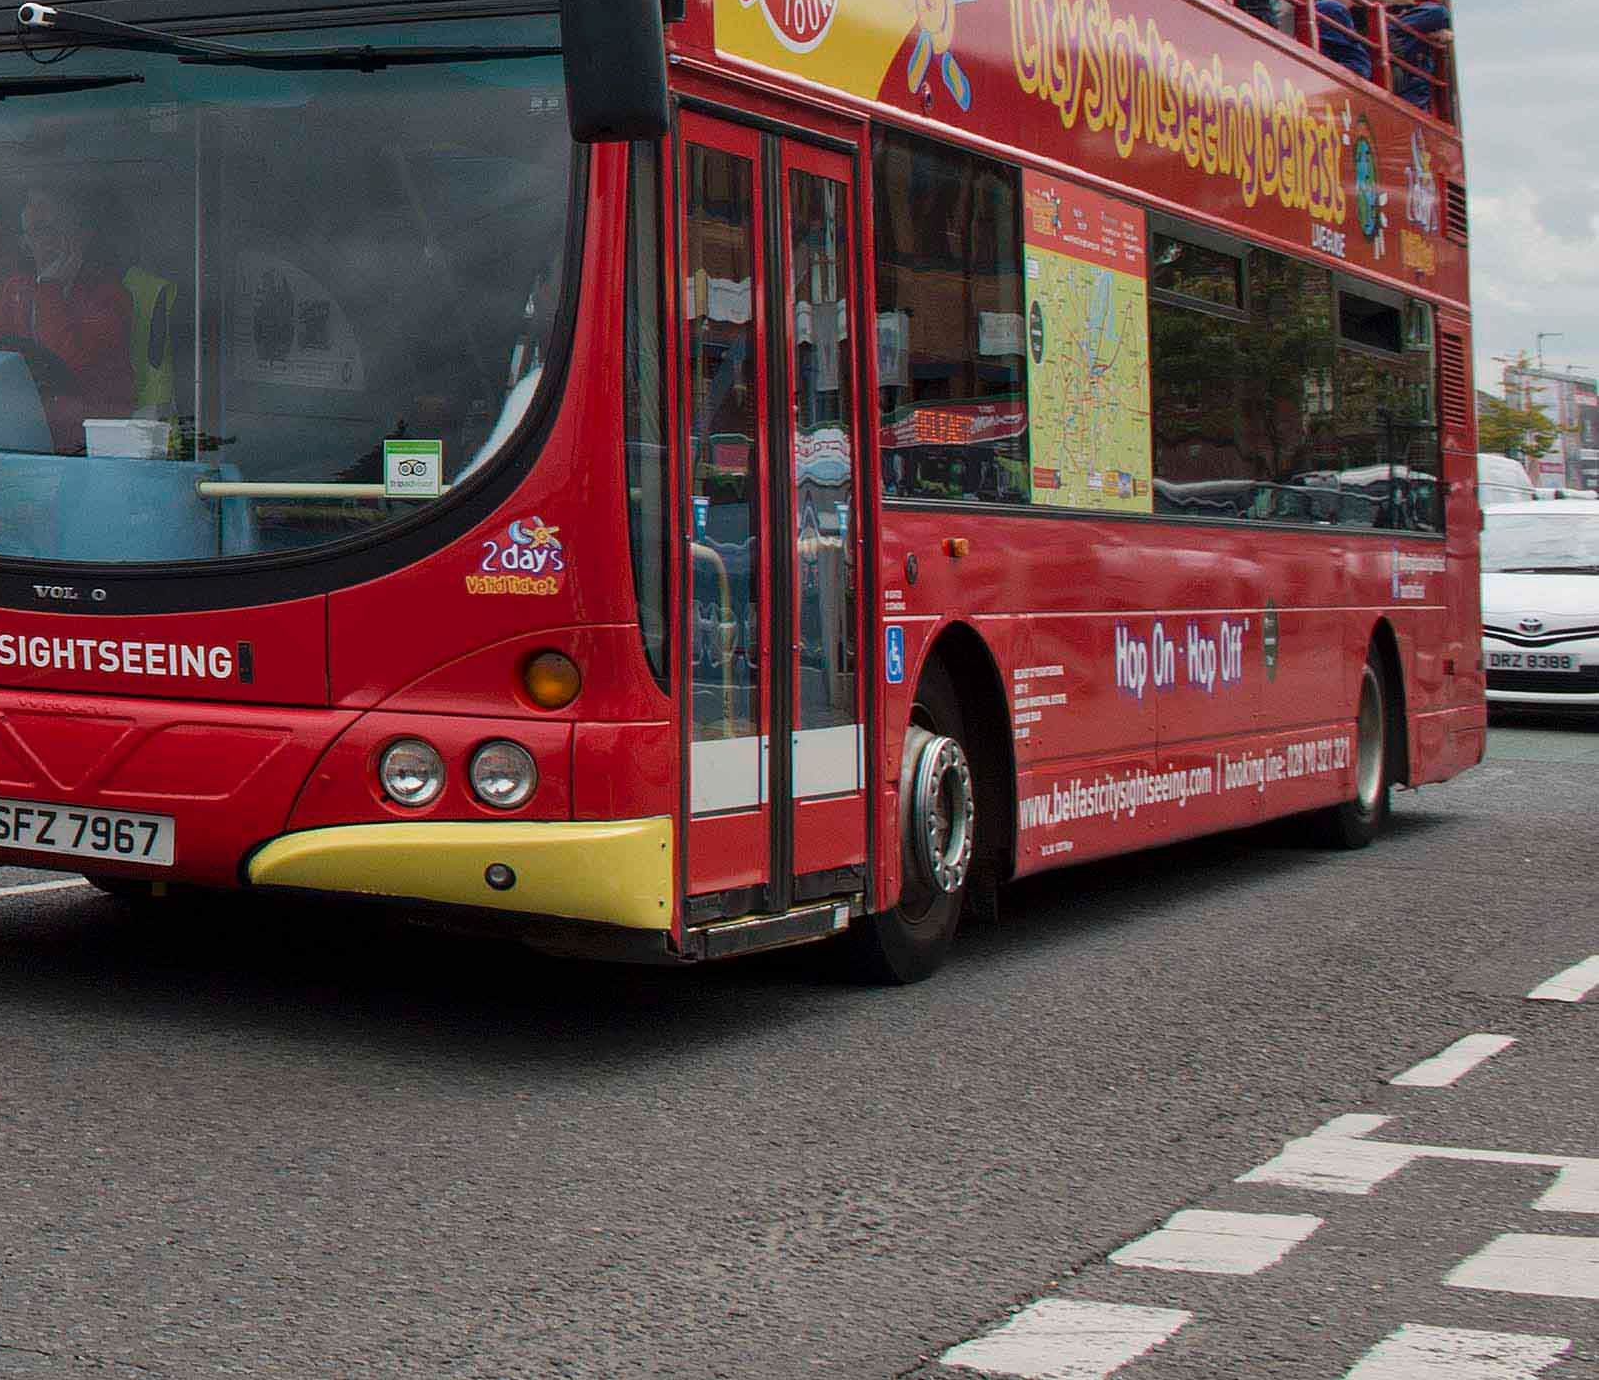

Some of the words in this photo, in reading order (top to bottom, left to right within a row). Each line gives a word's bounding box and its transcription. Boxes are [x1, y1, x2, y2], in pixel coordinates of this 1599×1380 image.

[1115, 625, 1147, 699] Hop
[1153, 622, 1175, 687] On
[1187, 624, 1217, 693] Hop
[1221, 620, 1243, 682] Off
[1490, 652, 1522, 668] DRZ
[1019, 763, 1212, 829] www.belfastcitysightseeing.com
[1225, 751, 1264, 792] booking
[1287, 743, 1304, 778] 028
[68, 813, 160, 857] 7967
